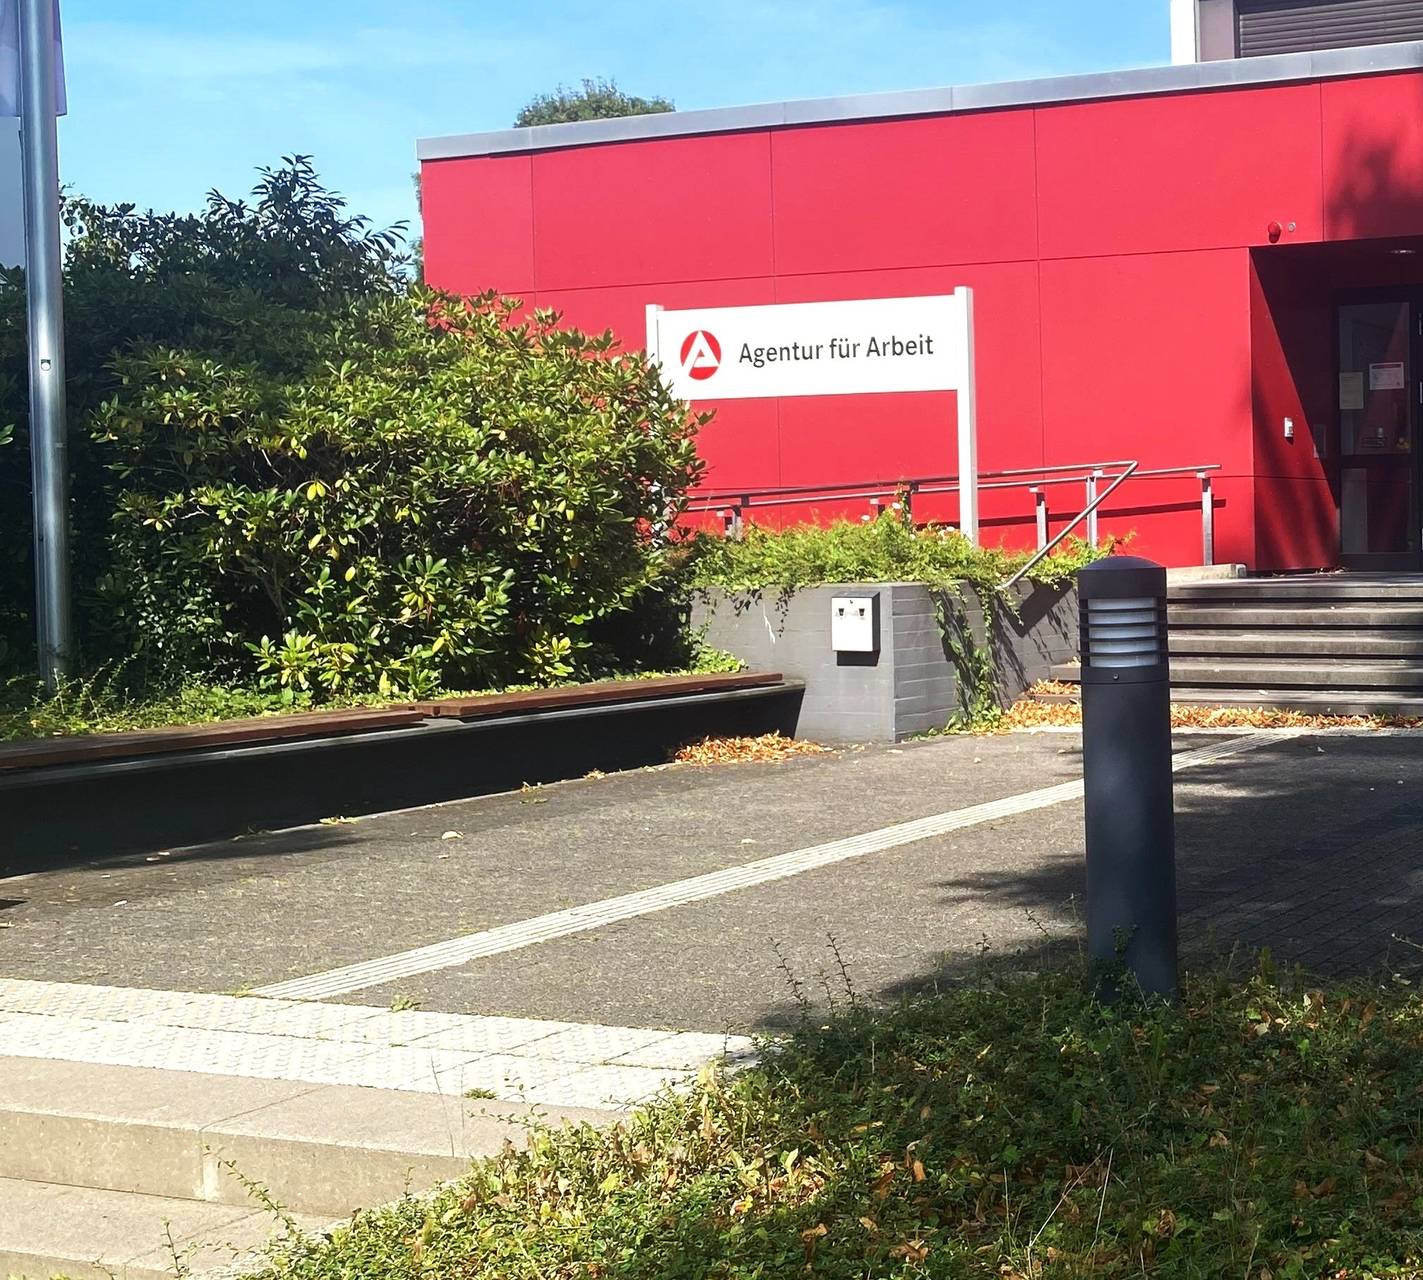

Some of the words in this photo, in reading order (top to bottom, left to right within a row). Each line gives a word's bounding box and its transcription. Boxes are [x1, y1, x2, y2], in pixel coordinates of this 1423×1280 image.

[739, 341, 824, 369] Agentur
[829, 338, 861, 359] für
[866, 334, 934, 357] Arbeit
